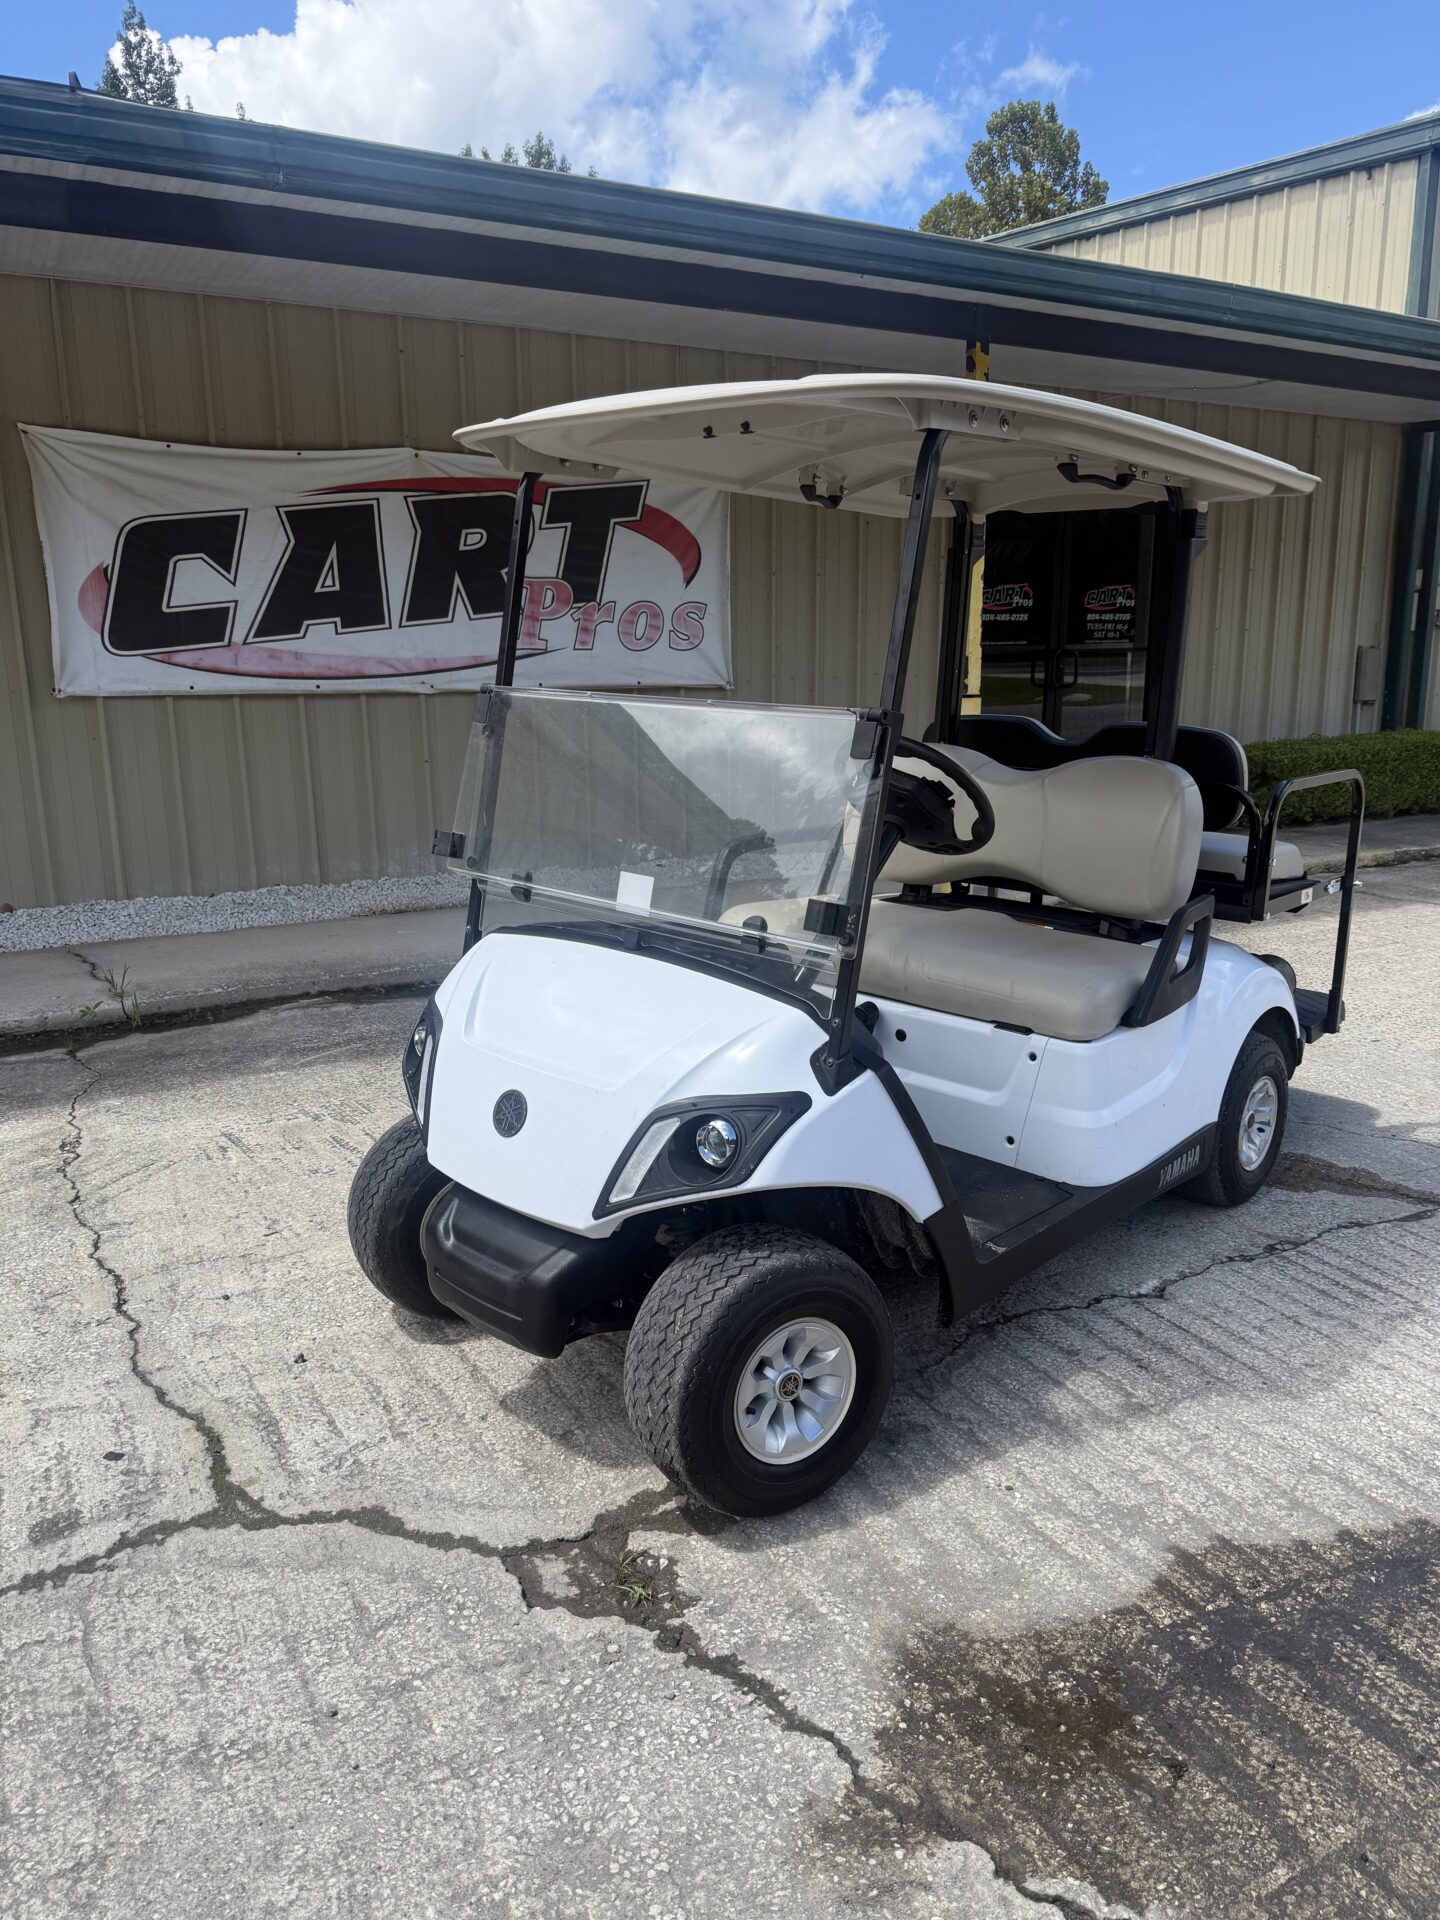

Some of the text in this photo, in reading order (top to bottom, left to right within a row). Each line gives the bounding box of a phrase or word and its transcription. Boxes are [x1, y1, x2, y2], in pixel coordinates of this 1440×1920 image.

[103, 480, 650, 657] CART
[1012, 596, 1033, 607] Pros
[1085, 585, 1131, 607] CART
[1116, 596, 1135, 607] Pros
[515, 577, 708, 651] Pros
[1158, 1144, 1200, 1188] YAMAHA
